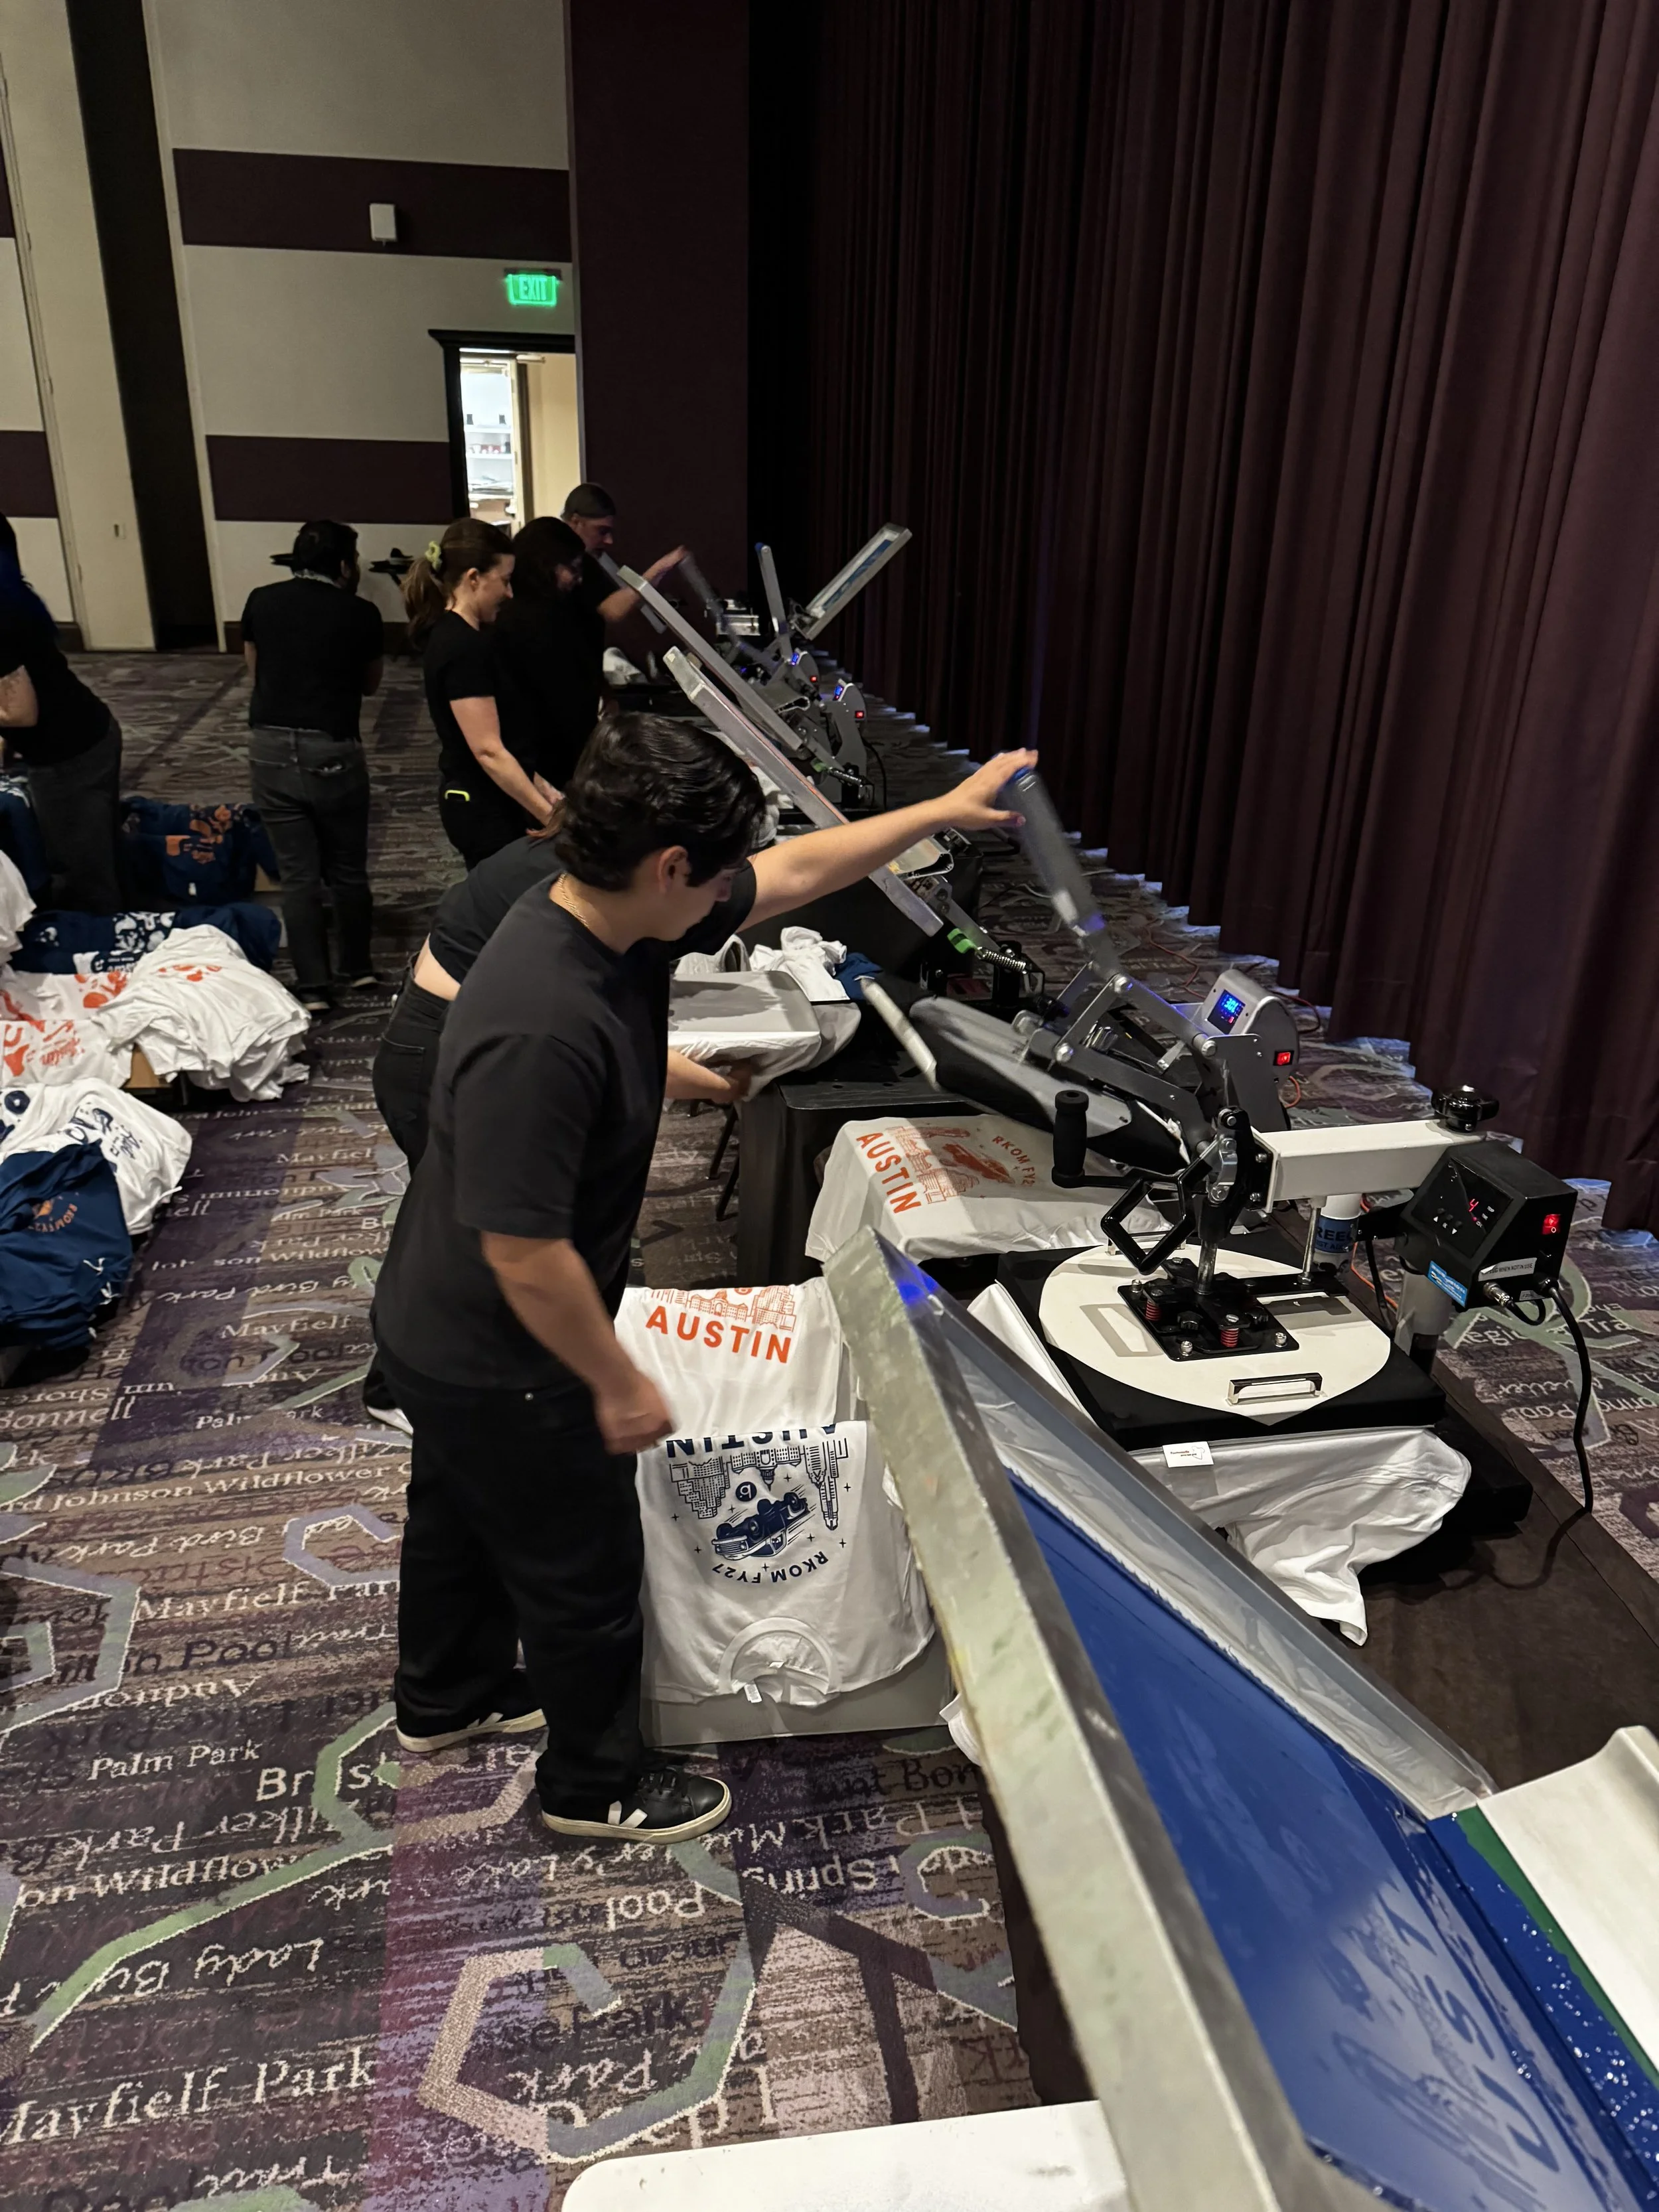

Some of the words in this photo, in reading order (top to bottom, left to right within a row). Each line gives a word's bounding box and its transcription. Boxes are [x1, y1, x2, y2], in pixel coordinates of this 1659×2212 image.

[519, 276, 547, 301] EXIT
[275, 1147, 372, 1163] Mayfiel
[855, 1132, 922, 1215] AUSTIN
[992, 1136, 1031, 1166] RKOM
[1021, 1166, 1037, 1187] FY2
[269, 1246, 389, 1262] Wildflow
[157, 1286, 236, 1303] Park
[246, 1280, 319, 1298] Bird
[645, 1305, 792, 1364] AUSTIN
[195, 1412, 253, 1430] Pal
[285, 1404, 325, 1420] ark
[181, 1451, 269, 1479] Park
[48, 1485, 194, 1513] Johnson
[202, 1465, 392, 1495] Wildflower
[56, 1536, 159, 1563] Park
[170, 1525, 265, 1554] Bird
[711, 1562, 761, 1585] FY27
[770, 1550, 830, 1584] RKOM
[179, 1630, 292, 1671] Pool
[68, 1674, 263, 1712] Auditor
[86, 1751, 174, 1781] Palm
[187, 1738, 263, 1768] Park
[792, 1799, 938, 1852] Park
[55, 1820, 185, 1872] Park
[605, 1881, 705, 1931] Pool
[194, 1937, 325, 1987] Lady
[252, 2045, 376, 2104] Park
